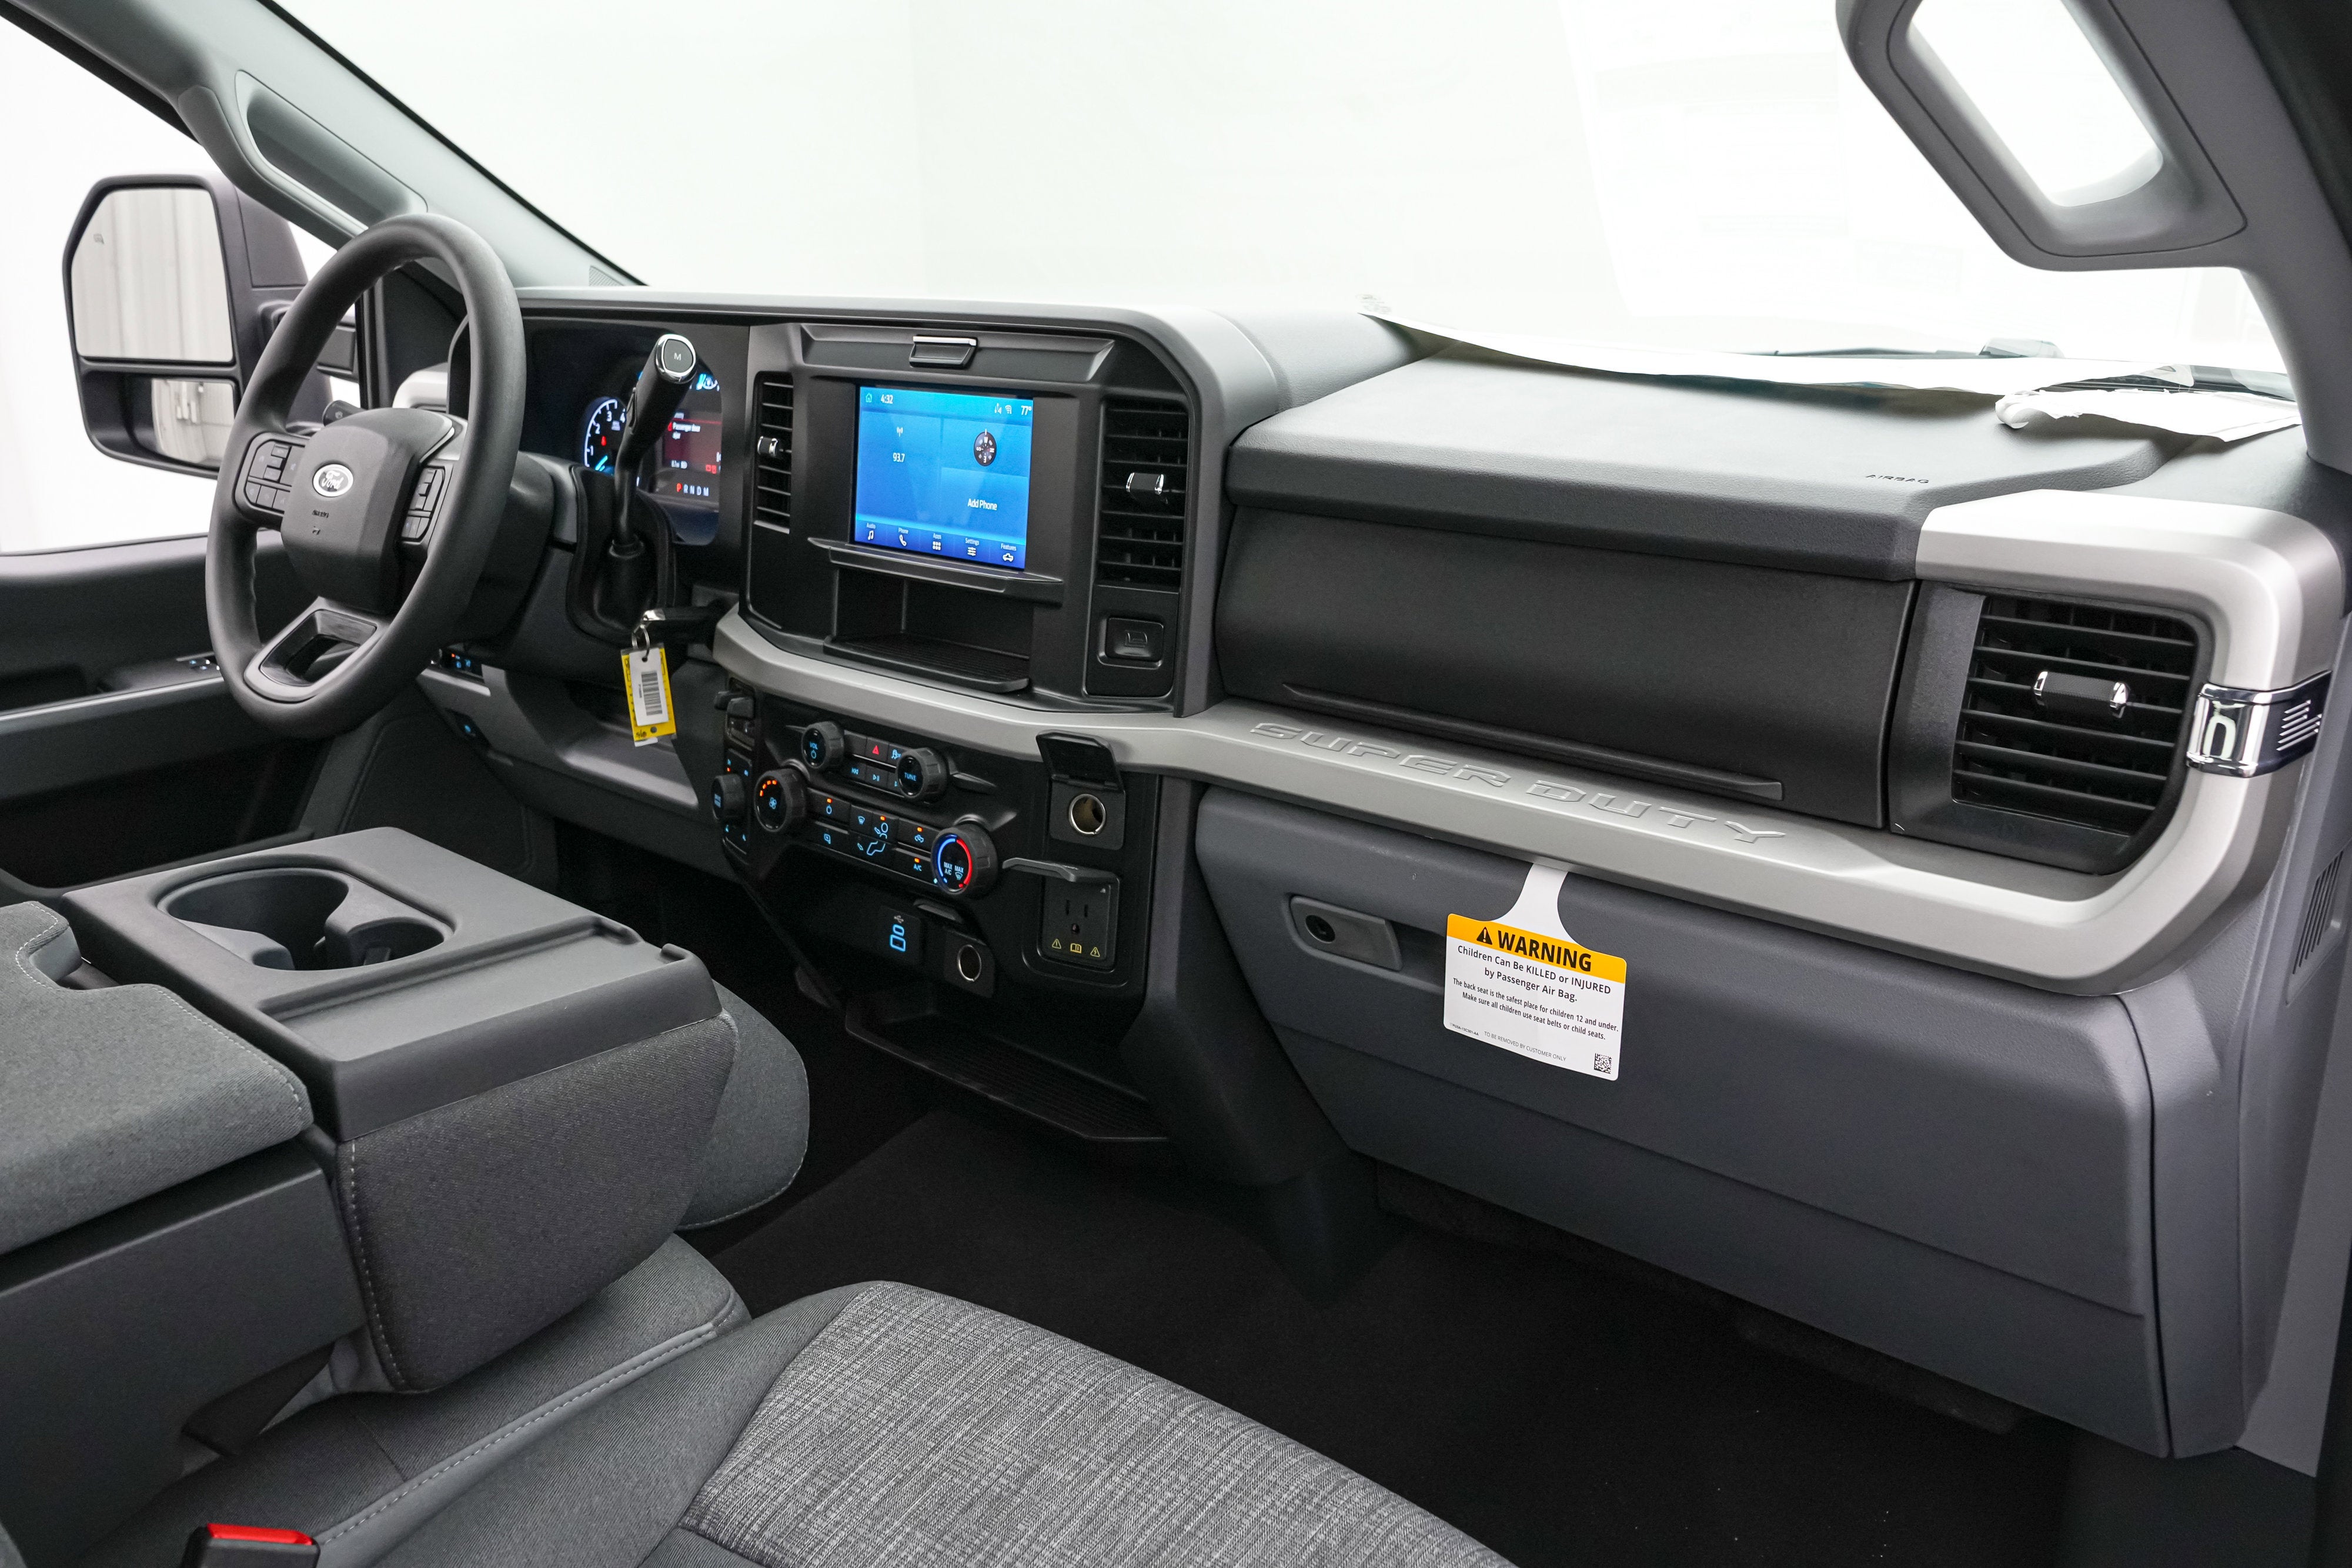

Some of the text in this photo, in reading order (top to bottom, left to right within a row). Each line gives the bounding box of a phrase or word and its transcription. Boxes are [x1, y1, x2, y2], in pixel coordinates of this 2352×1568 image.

[674, 352, 681, 360] M
[880, 394, 893, 404] 4:32
[893, 452, 906, 463] 93.7
[321, 470, 345, 490] Ford
[1865, 474, 1929, 484] AIRBAG
[967, 498, 997, 511] Add Phone
[1000, 543, 1017, 551] Features
[904, 772, 917, 781] TUNE
[1250, 722, 1786, 844] SUPER DUTY
[1498, 930, 1592, 972] WARNING
[1458, 945, 1492, 962] Children
[1495, 956, 1511, 968] Can
[1513, 961, 1524, 971] Be
[1526, 965, 1556, 980] KILLED
[1571, 977, 1611, 994] INJURED
[1485, 967, 1578, 1003] by Passenger Air Bag.
[1453, 978, 1462, 987] The
[1464, 981, 1476, 991] back
[1477, 987, 1488, 995] seat
[1506, 996, 1522, 1005] safest
[1524, 1001, 1538, 1011] place
[1539, 1004, 1548, 1013] for
[1549, 1008, 1574, 1020] children
[1585, 1017, 1596, 1026] and
[1598, 1022, 1619, 1032] under.
[1462, 992, 1477, 1002] Make
[1478, 998, 1490, 1006] sure
[1499, 1004, 1521, 1016] children
[1522, 1012, 1532, 1020] use
[1533, 1015, 1545, 1024] seat
[1547, 1018, 1562, 1028] belts
[1571, 1025, 1586, 1035] child
[1588, 1030, 1606, 1039] seats.
[1498, 1035, 1519, 1047] REMOVED
[1526, 1045, 1552, 1058] CUSTOMER
[1552, 1054, 1566, 1062] ONLY
